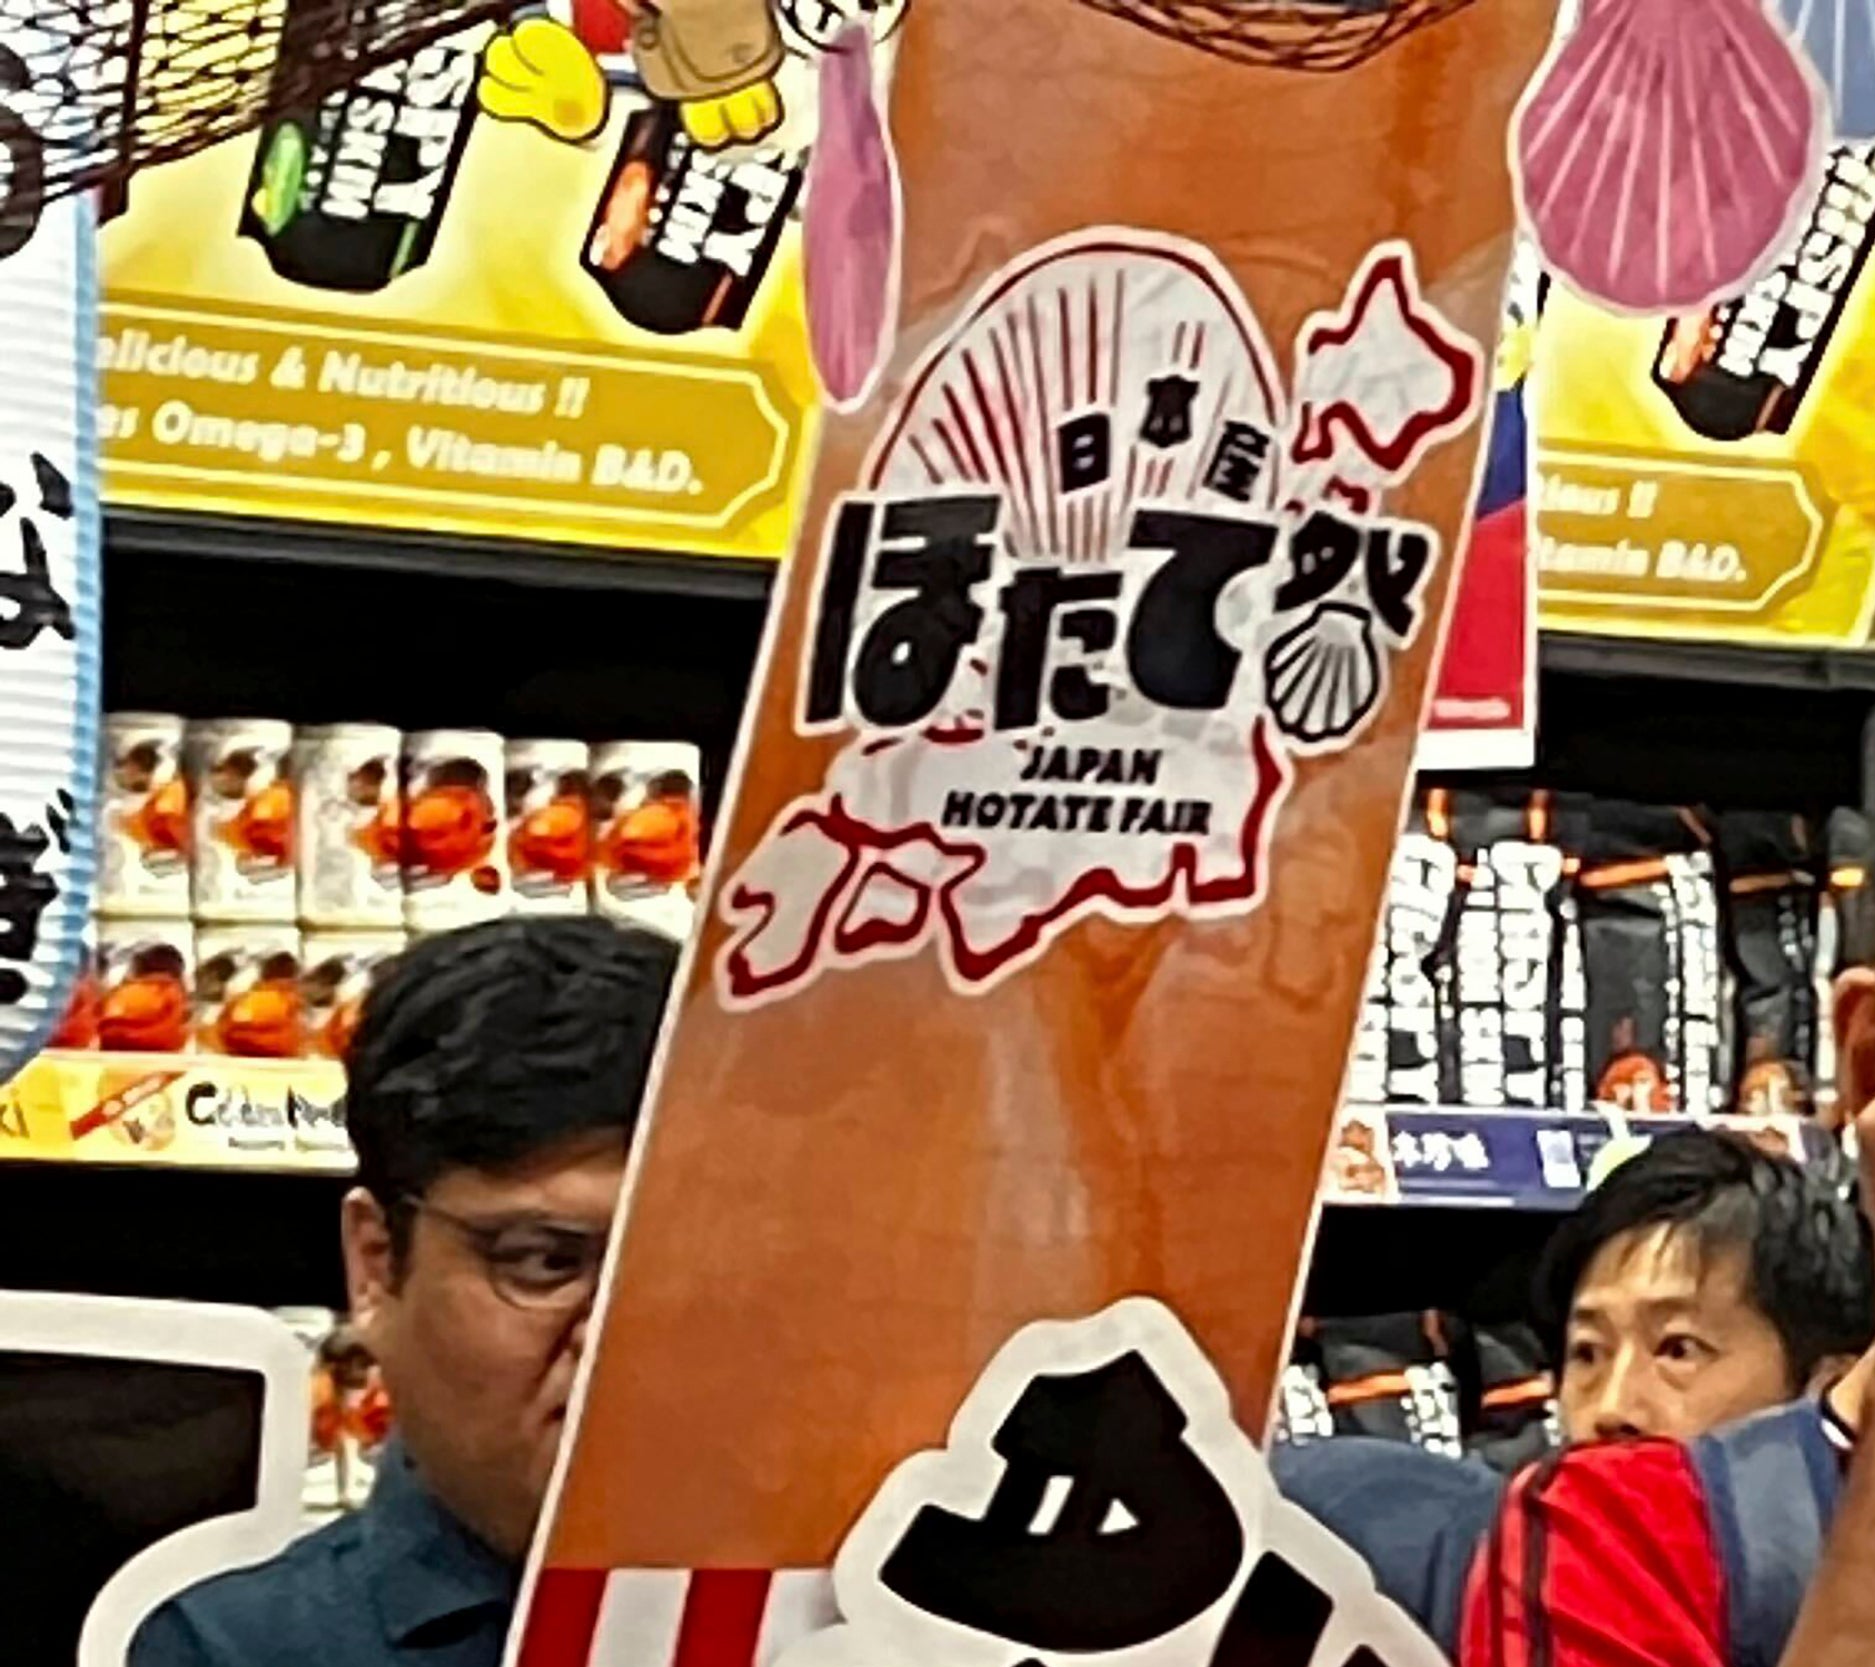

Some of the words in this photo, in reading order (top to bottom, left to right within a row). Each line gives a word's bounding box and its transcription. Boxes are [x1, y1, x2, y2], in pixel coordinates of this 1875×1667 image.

[96, 331, 260, 386] elicious
[318, 350, 547, 414] Nutritious
[407, 426, 582, 483] Vitamin
[1532, 536, 1648, 576] tamin
[1018, 748, 1161, 786] JAPAN
[942, 793, 1109, 833] HOTATE
[1118, 795, 1210, 835] FAIR
